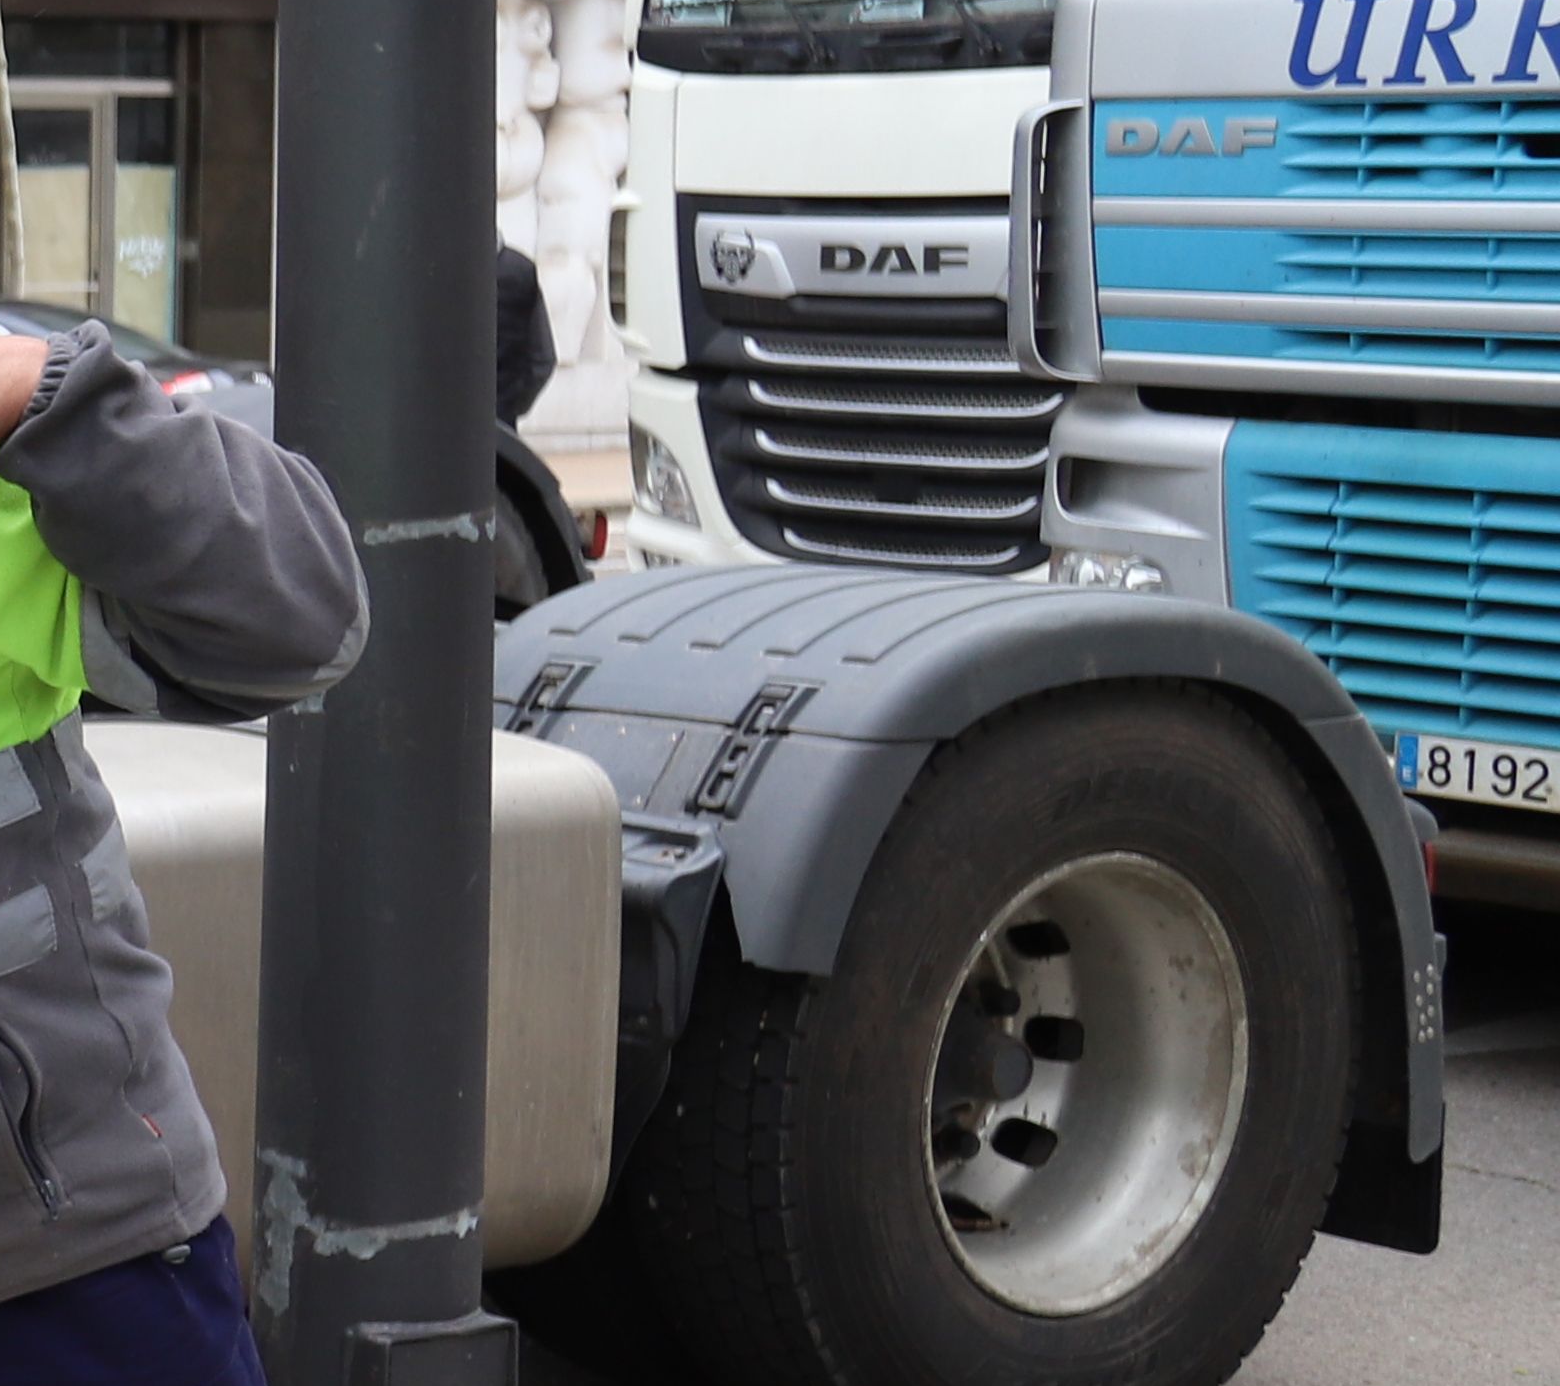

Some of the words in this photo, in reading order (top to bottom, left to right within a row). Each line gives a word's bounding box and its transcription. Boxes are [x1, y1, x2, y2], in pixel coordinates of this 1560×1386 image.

[1106, 116, 1277, 158] DAF
[819, 244, 969, 275] DAF
[1427, 745, 1550, 803] 8192
